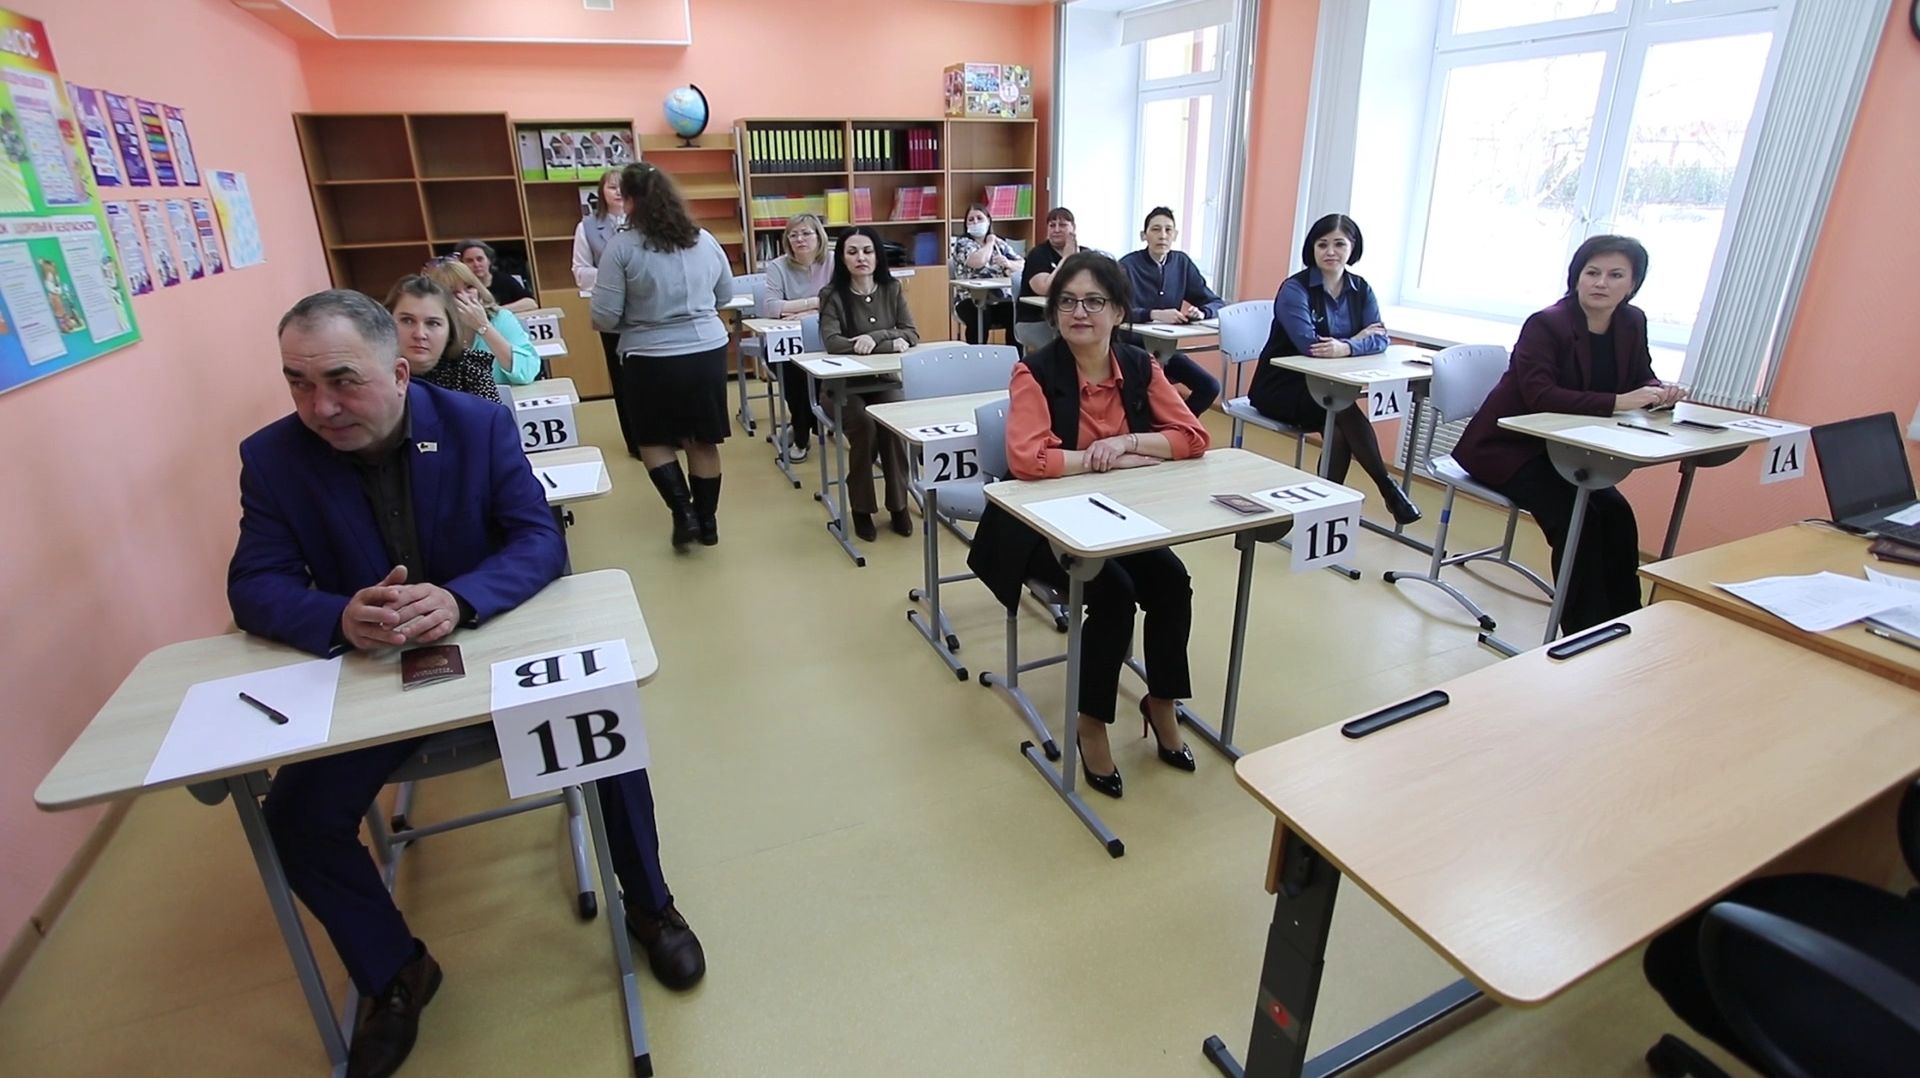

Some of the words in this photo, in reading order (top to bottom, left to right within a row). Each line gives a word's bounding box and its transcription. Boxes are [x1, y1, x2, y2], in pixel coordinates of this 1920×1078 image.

[528, 323, 554, 341] 5В
[774, 336, 803, 356] 4Б
[1373, 390, 1400, 416] 2А
[522, 418, 568, 448] 3В
[932, 448, 979, 483] 2Б
[1767, 442, 1799, 475] 1А
[1270, 485, 1330, 505] 1Б
[1304, 516, 1349, 562] 1Б
[515, 647, 608, 688] 1В
[527, 708, 627, 777] 1В
